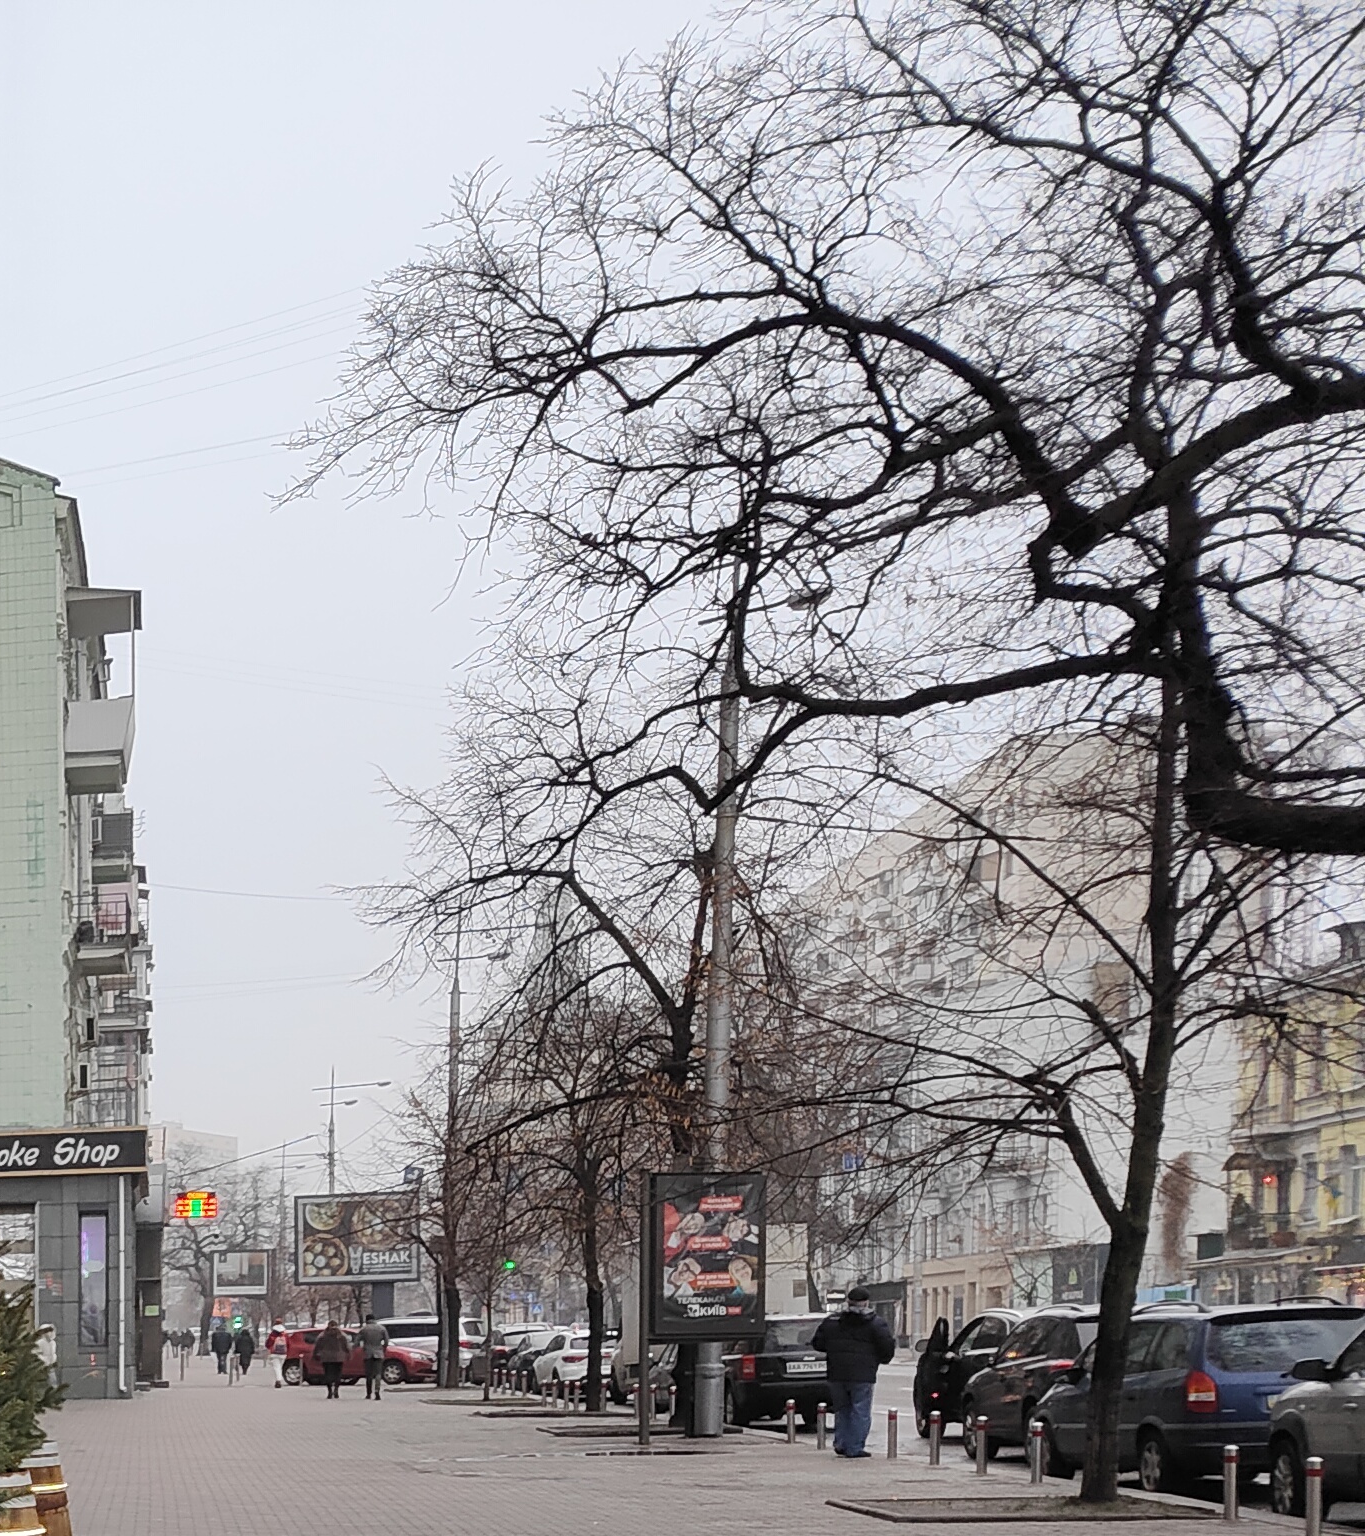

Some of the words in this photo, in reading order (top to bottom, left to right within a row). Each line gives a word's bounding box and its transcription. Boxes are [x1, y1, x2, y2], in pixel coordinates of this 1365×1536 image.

[53, 1137, 120, 1167] Shop
[362, 1250, 411, 1265] ESHAK
[699, 1303, 727, 1316] КИЇВ
